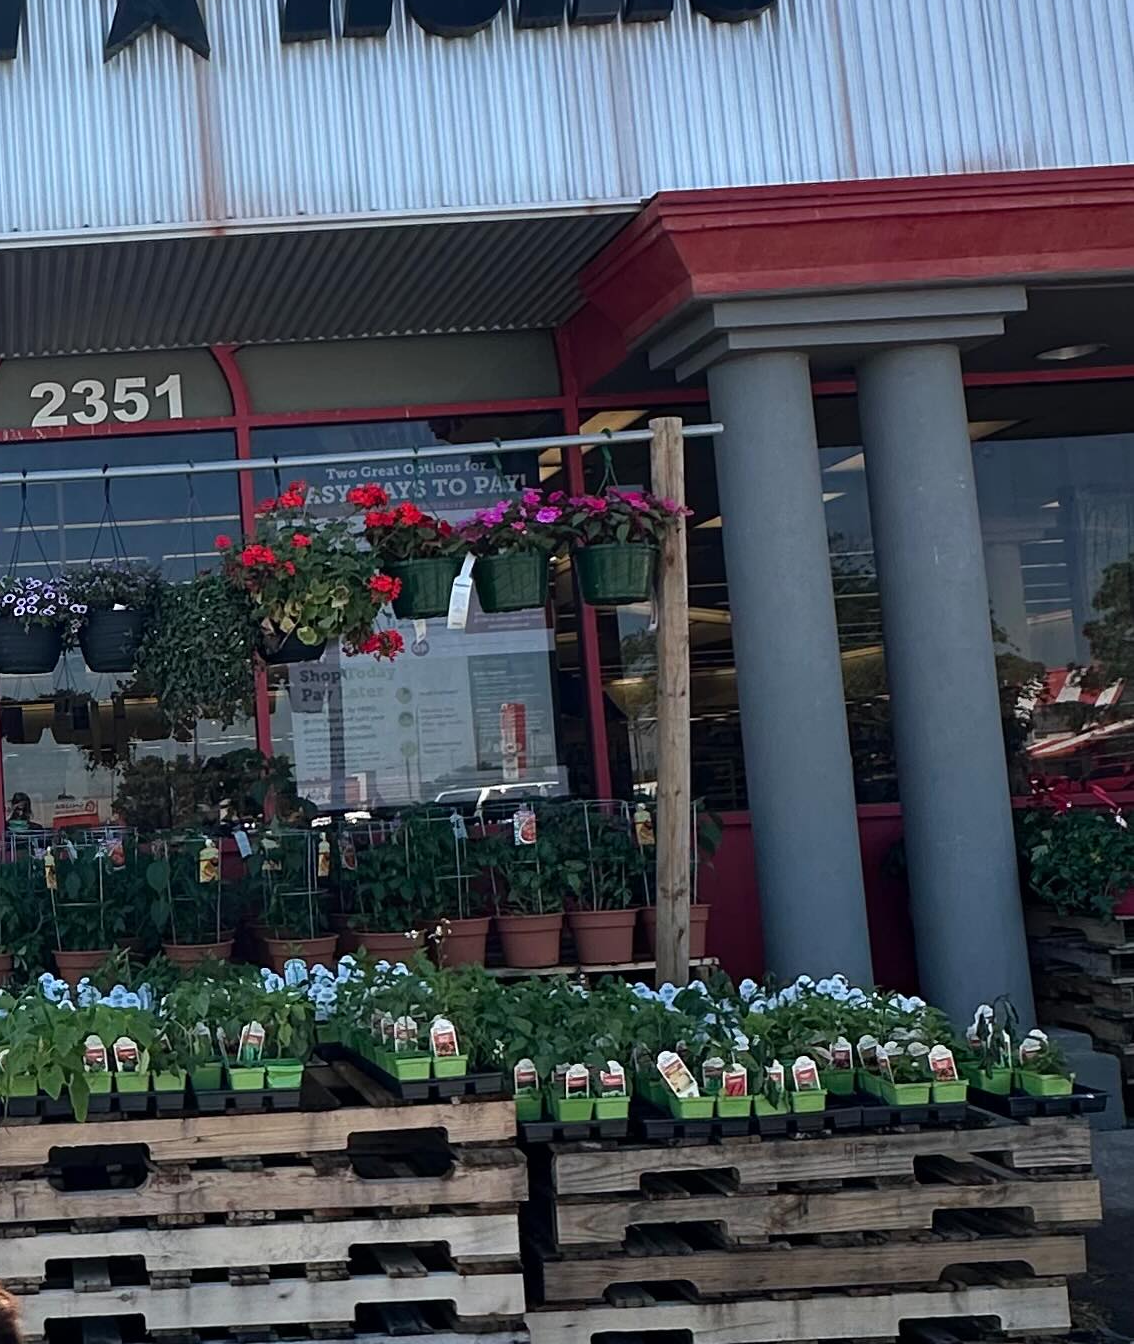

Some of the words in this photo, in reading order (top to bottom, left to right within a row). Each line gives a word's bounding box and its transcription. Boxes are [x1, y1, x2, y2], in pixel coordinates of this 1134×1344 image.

[30, 374, 183, 428] 2351
[326, 467, 357, 480] Two
[361, 464, 399, 478] Great
[465, 459, 486, 472] for
[305, 483, 350, 505] ASY
[432, 477, 468, 498] TO
[474, 473, 528, 495] PAY!
[299, 669, 341, 684] Shop
